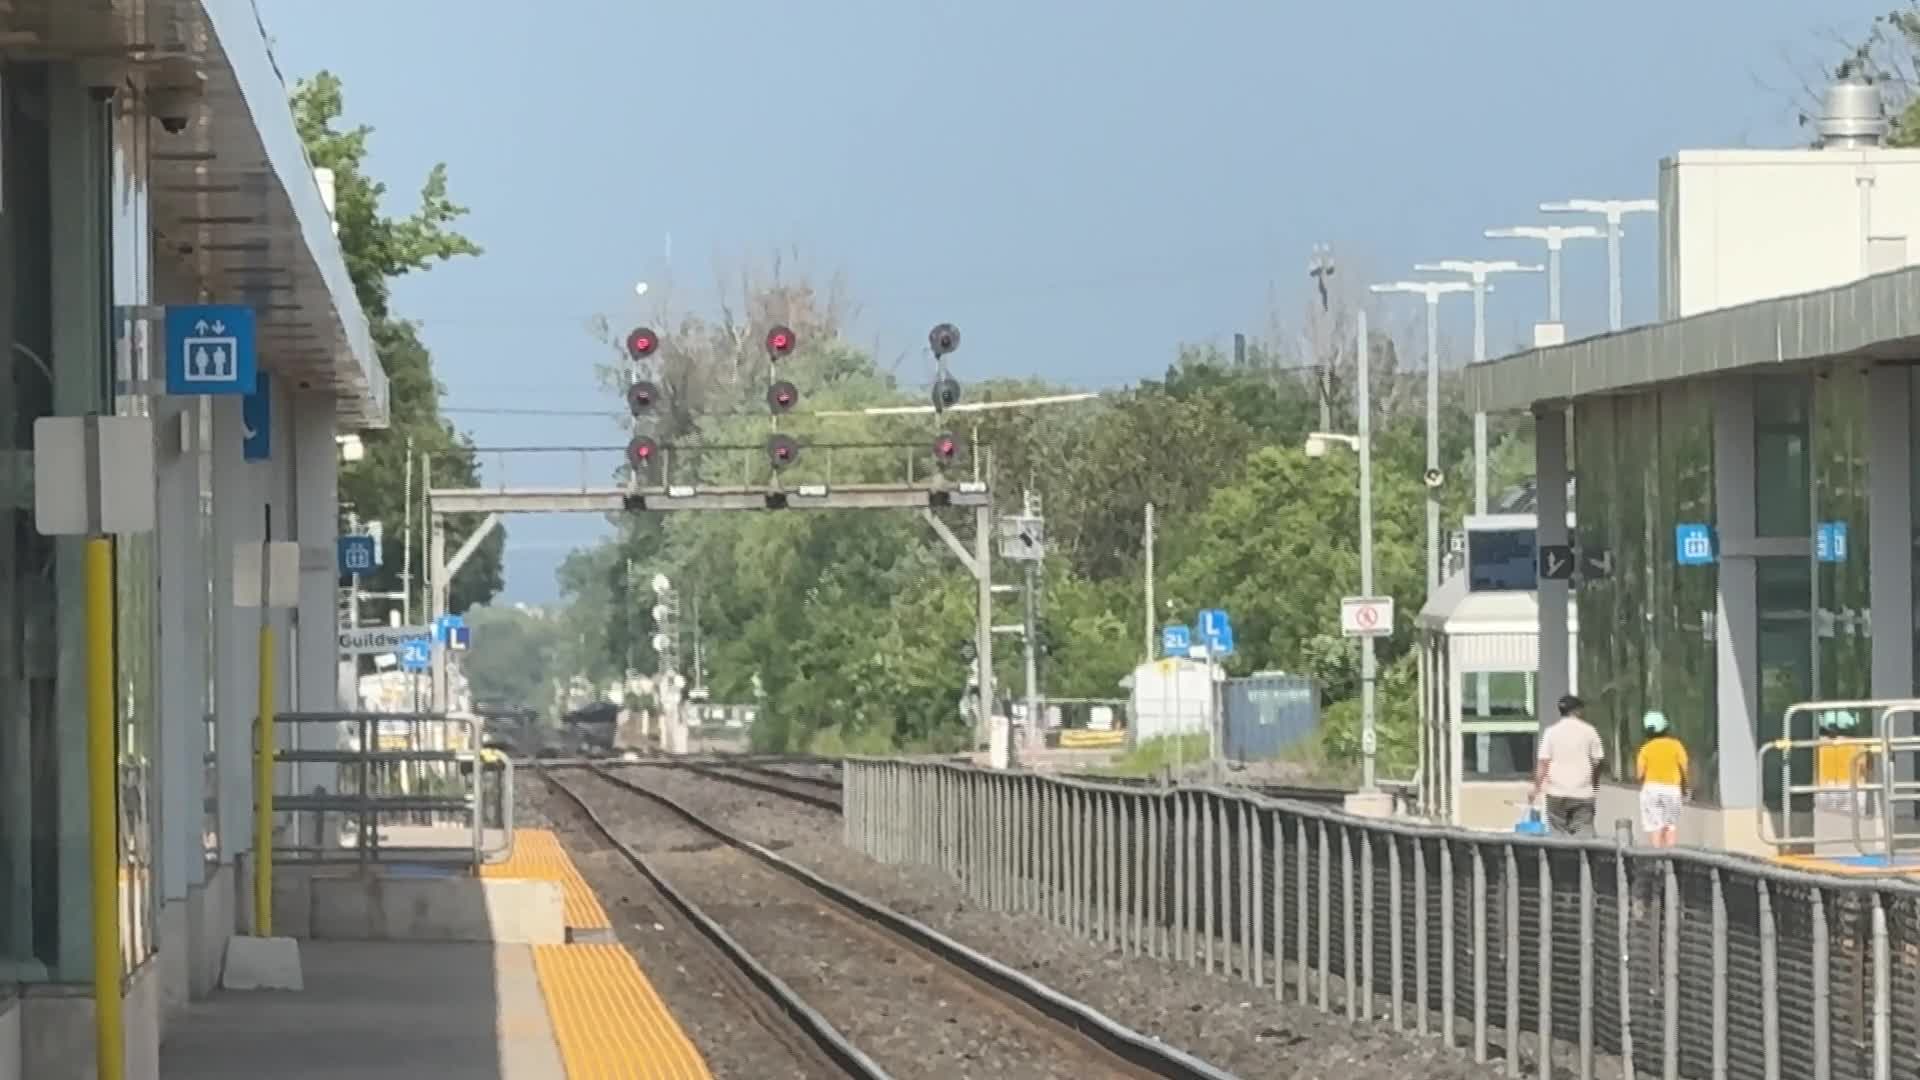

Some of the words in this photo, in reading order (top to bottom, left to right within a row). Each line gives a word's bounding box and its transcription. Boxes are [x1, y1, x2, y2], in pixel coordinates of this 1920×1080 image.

[450, 627, 466, 649] L
[1164, 633, 1188, 648] 2L
[404, 645, 425, 661] 2L
